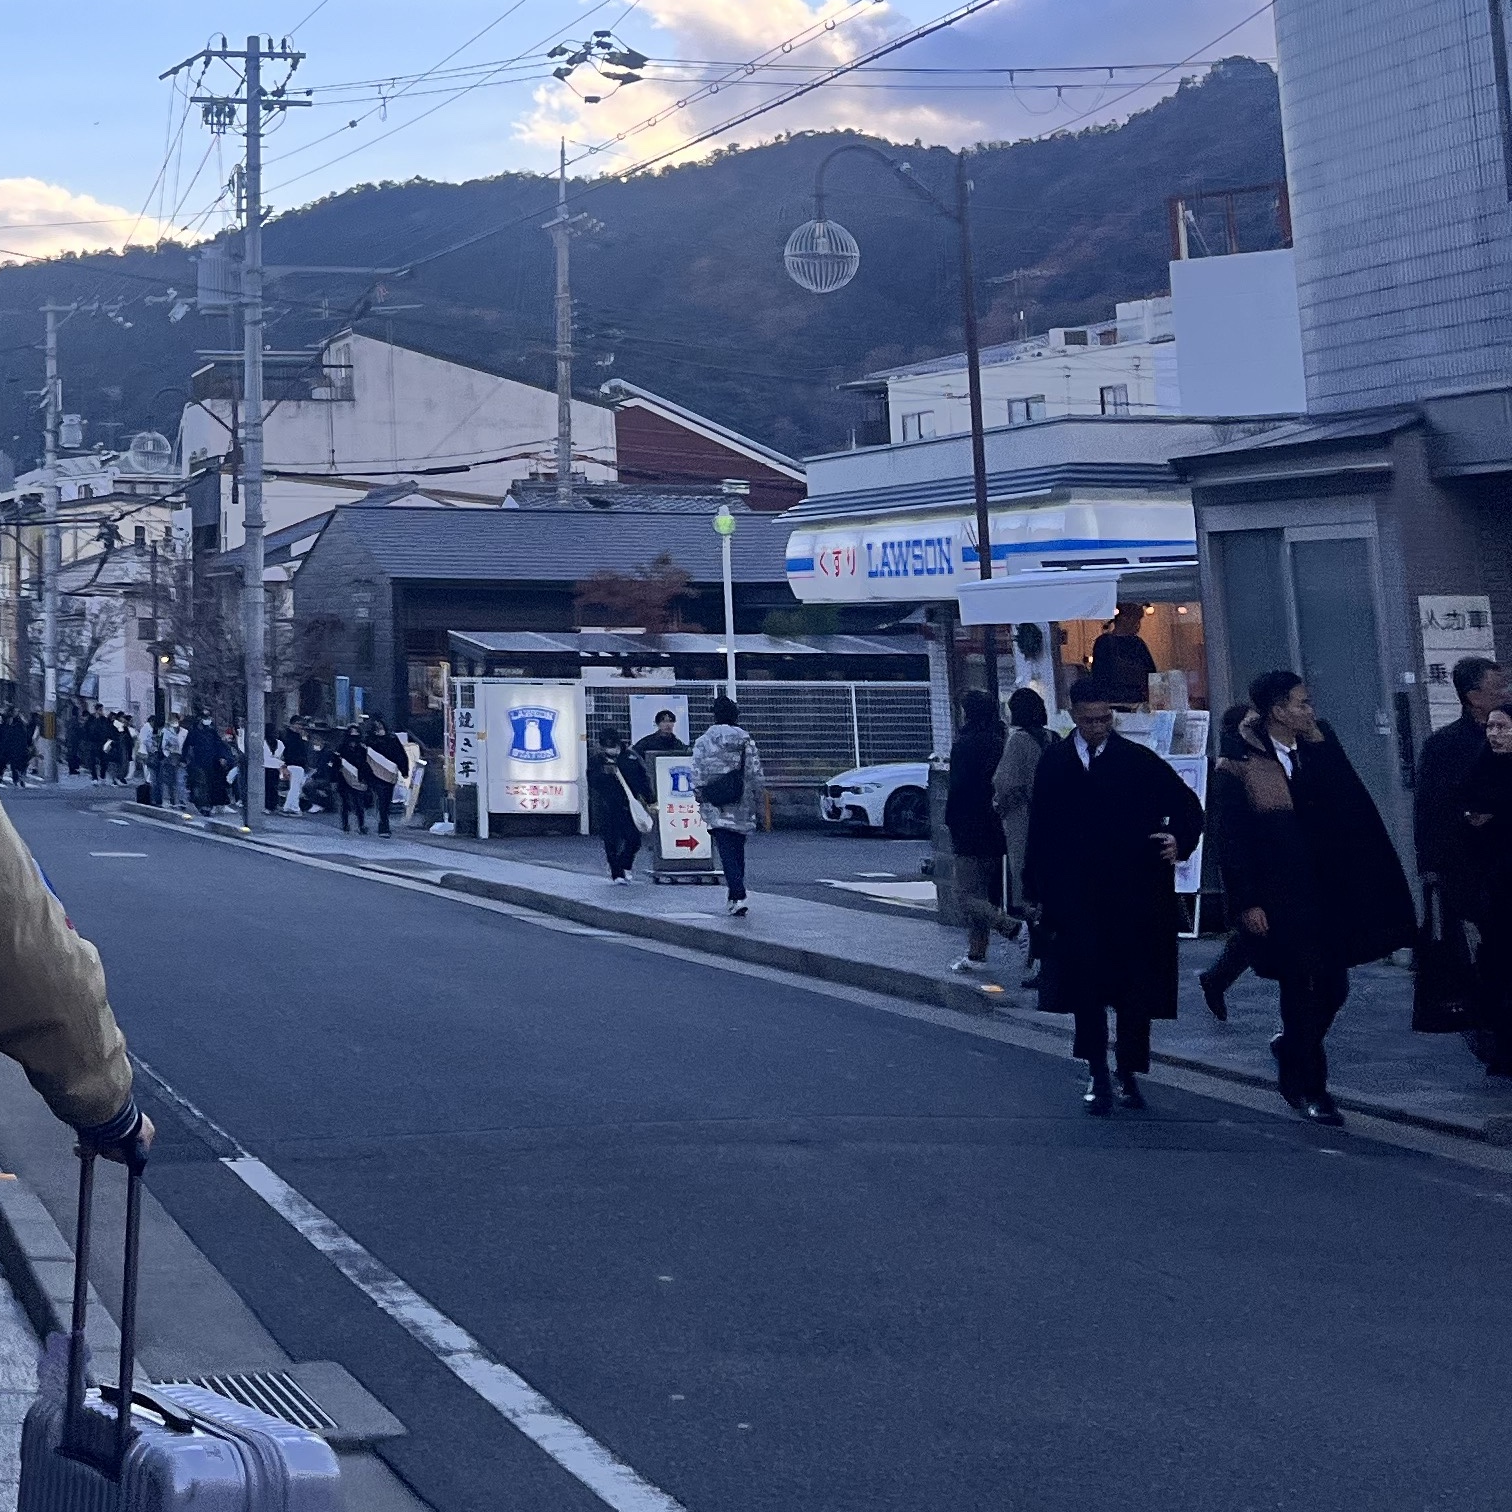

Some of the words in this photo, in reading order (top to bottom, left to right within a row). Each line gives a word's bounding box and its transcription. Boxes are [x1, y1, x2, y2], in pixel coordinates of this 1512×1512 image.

[819, 547, 856, 578] くすり
[866, 537, 954, 578] LAWSON
